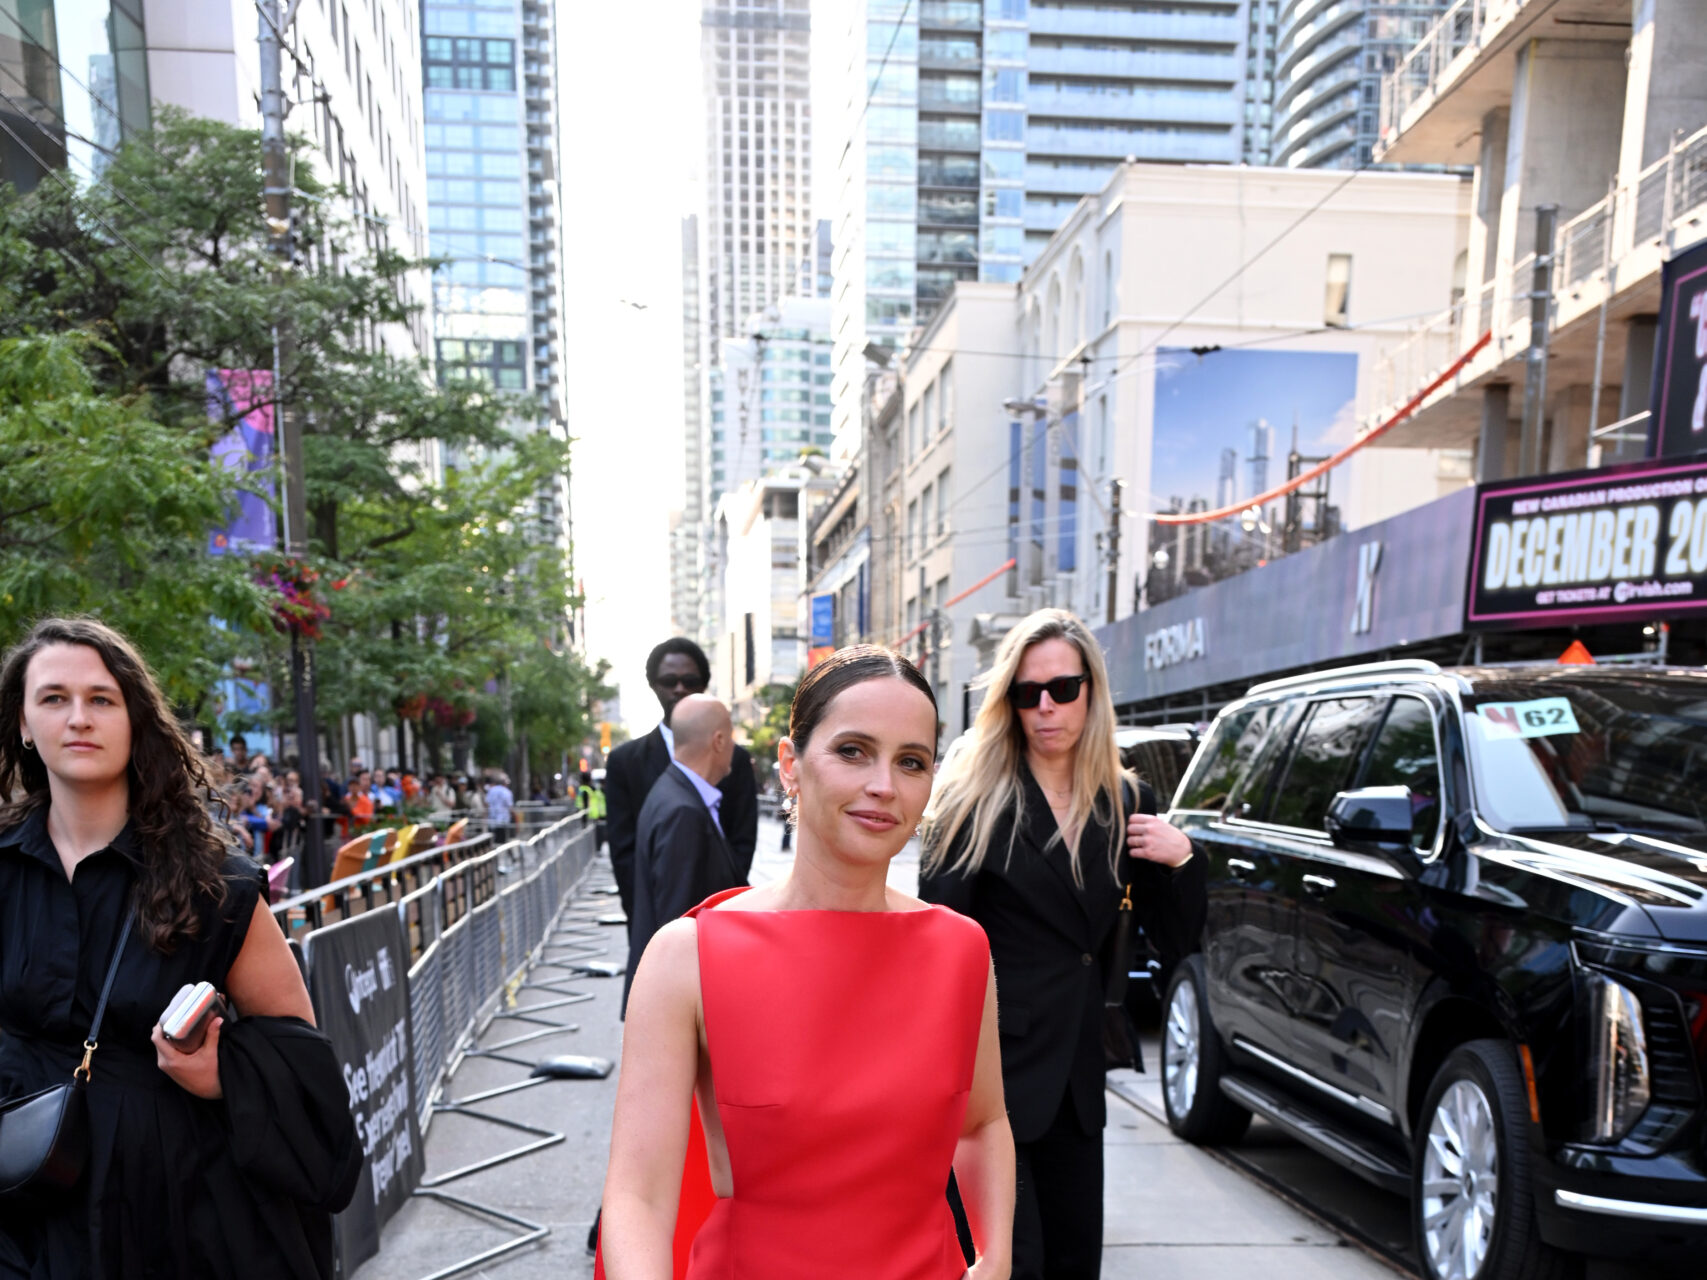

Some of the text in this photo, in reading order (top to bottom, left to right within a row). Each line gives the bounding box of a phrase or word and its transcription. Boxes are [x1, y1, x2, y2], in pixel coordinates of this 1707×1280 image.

[1512, 498, 1540, 515] NEW
[1541, 490, 1606, 511] CANADIAN
[1608, 479, 1693, 502] PRODUCTION
[1484, 505, 1660, 589] DECEMBER
[1556, 587, 1598, 604] TICKETS
[1144, 618, 1204, 671] FORMA
[1524, 708, 1568, 727] 62
